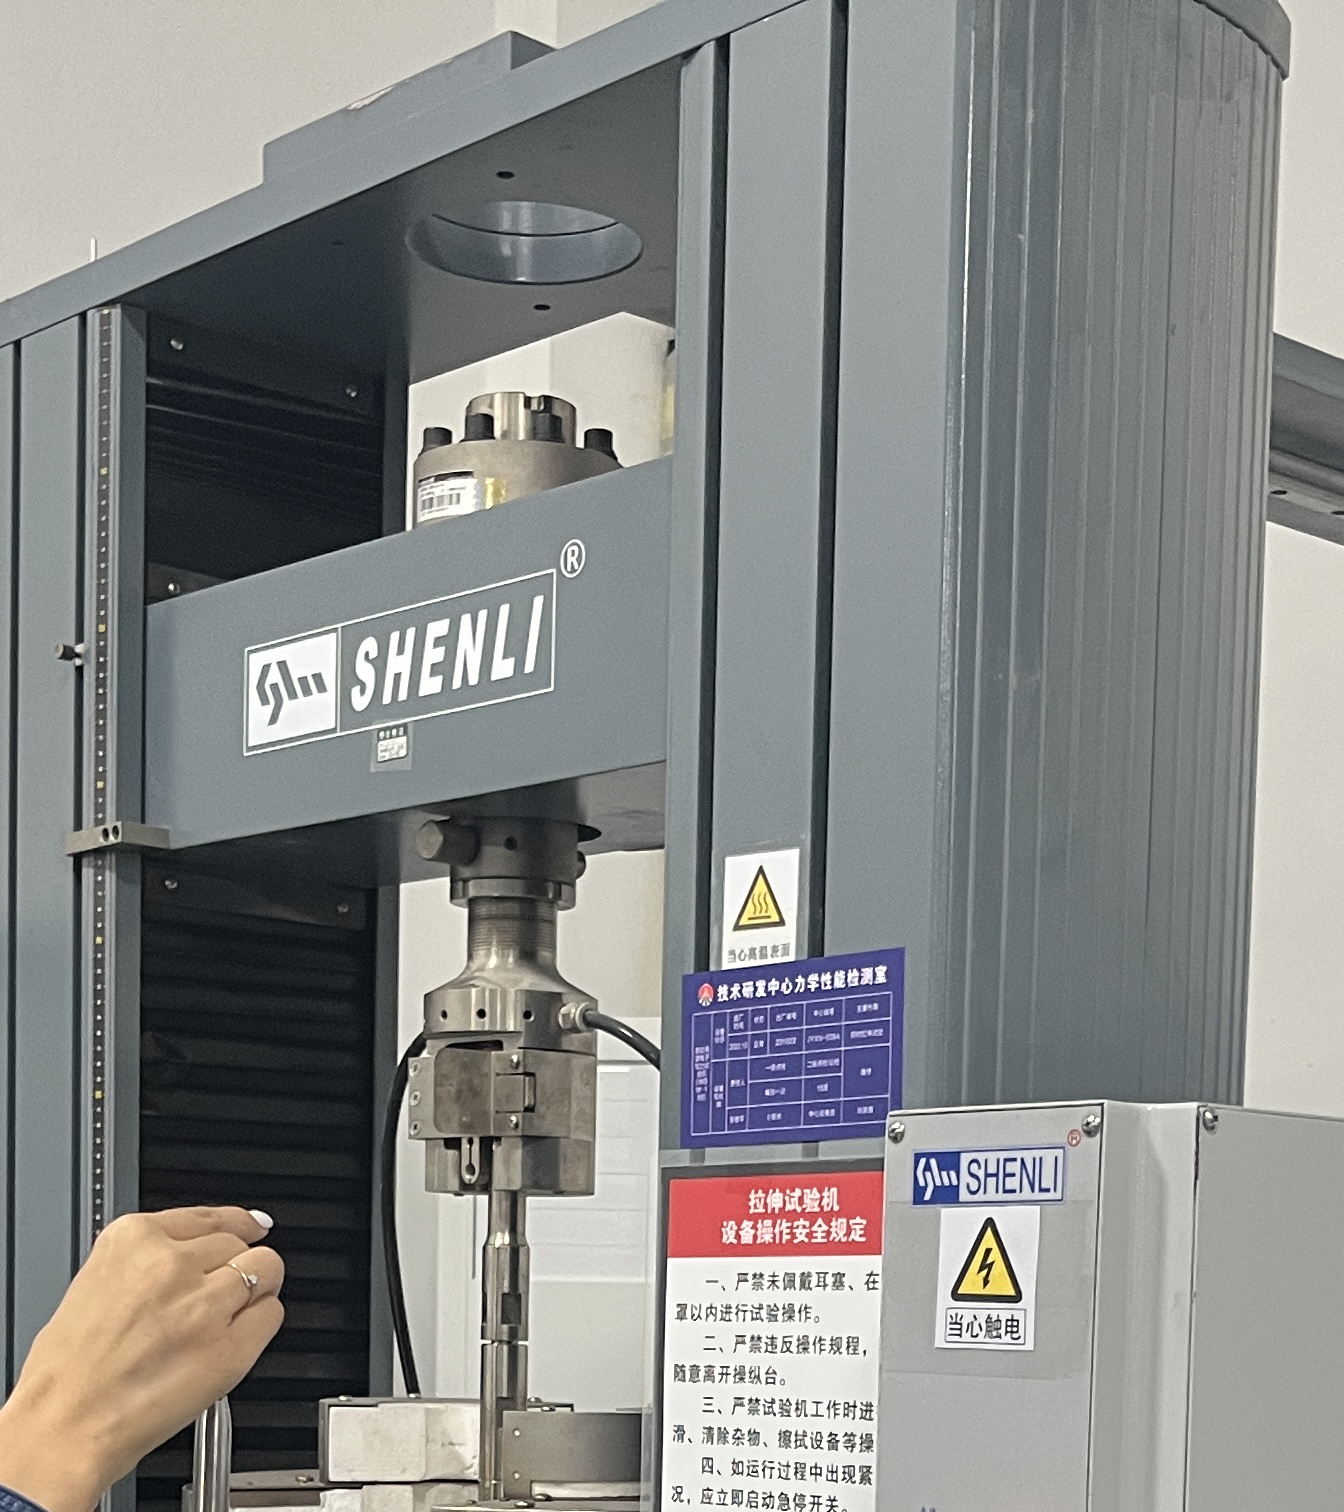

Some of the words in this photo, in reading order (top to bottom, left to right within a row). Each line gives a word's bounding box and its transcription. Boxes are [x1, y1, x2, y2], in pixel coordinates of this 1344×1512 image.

[350, 594, 547, 713] SHENLI
[727, 942, 791, 963] 当心高温表面
[717, 965, 888, 1002] 技术研发中心力学性能检测室
[966, 1155, 1059, 1196] SHENLI
[748, 1186, 839, 1214] 拉伸试验机
[721, 1216, 867, 1244] 设备操作安全规定
[705, 1270, 880, 1292] 一、严禁未佩戴耳塞、在
[674, 1303, 820, 1324] 罩以内进行试验操作。
[947, 1312, 1022, 1341] 当心触电
[673, 1363, 786, 1386] 随意离开操纵台。
[701, 1456, 873, 1486] 四、如运行过程中出现紧
